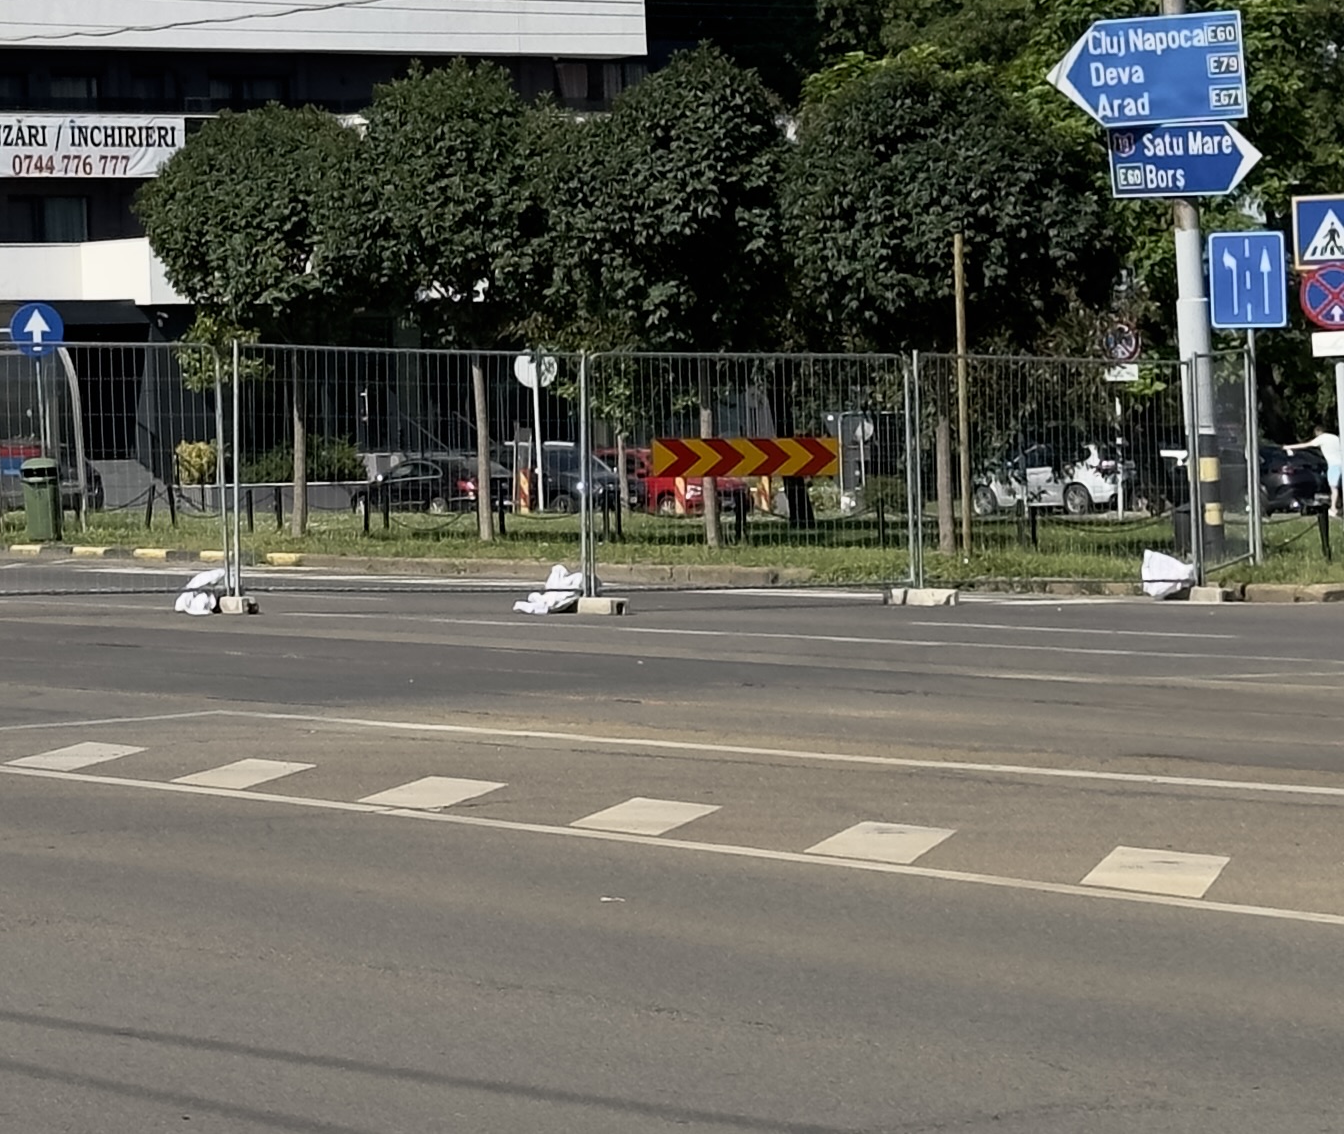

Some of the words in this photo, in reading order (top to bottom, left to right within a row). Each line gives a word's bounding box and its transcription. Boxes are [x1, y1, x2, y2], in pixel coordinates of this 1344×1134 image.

[1088, 29, 1126, 57] Cluj
[1129, 28, 1208, 55] Napoca
[1208, 25, 1235, 42] E60
[1090, 62, 1144, 87] Deva
[1210, 56, 1238, 73] E79
[1097, 92, 1150, 117] Arad
[1212, 89, 1242, 106] E671
[69, 119, 176, 147] ÎNCHIRIERI
[1143, 133, 1183, 156] Satu
[1188, 131, 1232, 154] Mare
[12, 154, 55, 175] 0744
[62, 154, 93, 175] 776
[99, 154, 130, 175] 777
[1119, 168, 1141, 186] E60
